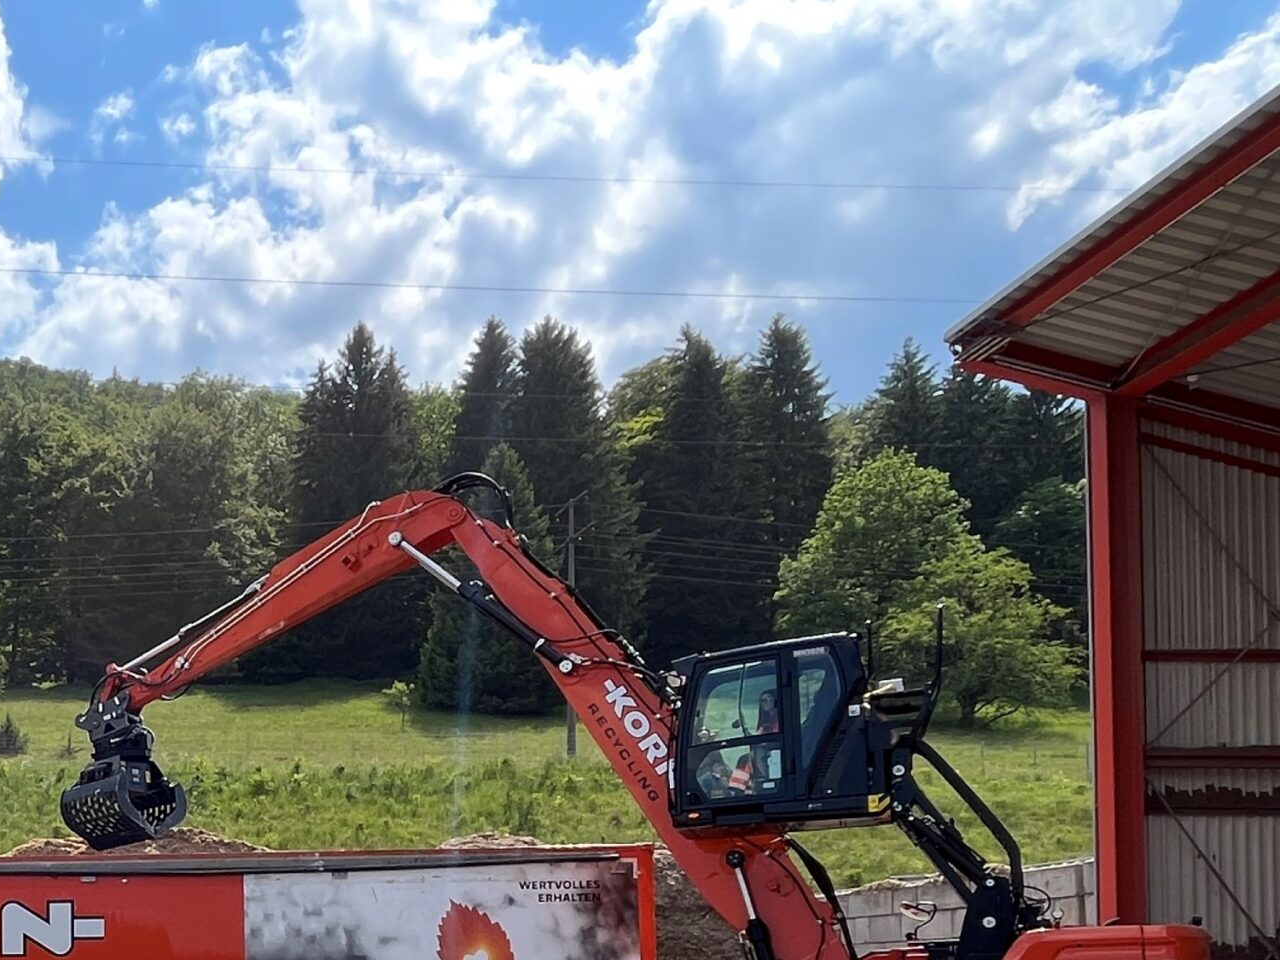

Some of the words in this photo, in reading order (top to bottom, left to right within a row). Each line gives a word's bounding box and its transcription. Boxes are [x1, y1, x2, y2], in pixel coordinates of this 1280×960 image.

[587, 703, 660, 802] RECYCLING
[519, 880, 600, 890] WERTVOLLES
[538, 893, 600, 903] ERHALTEN
